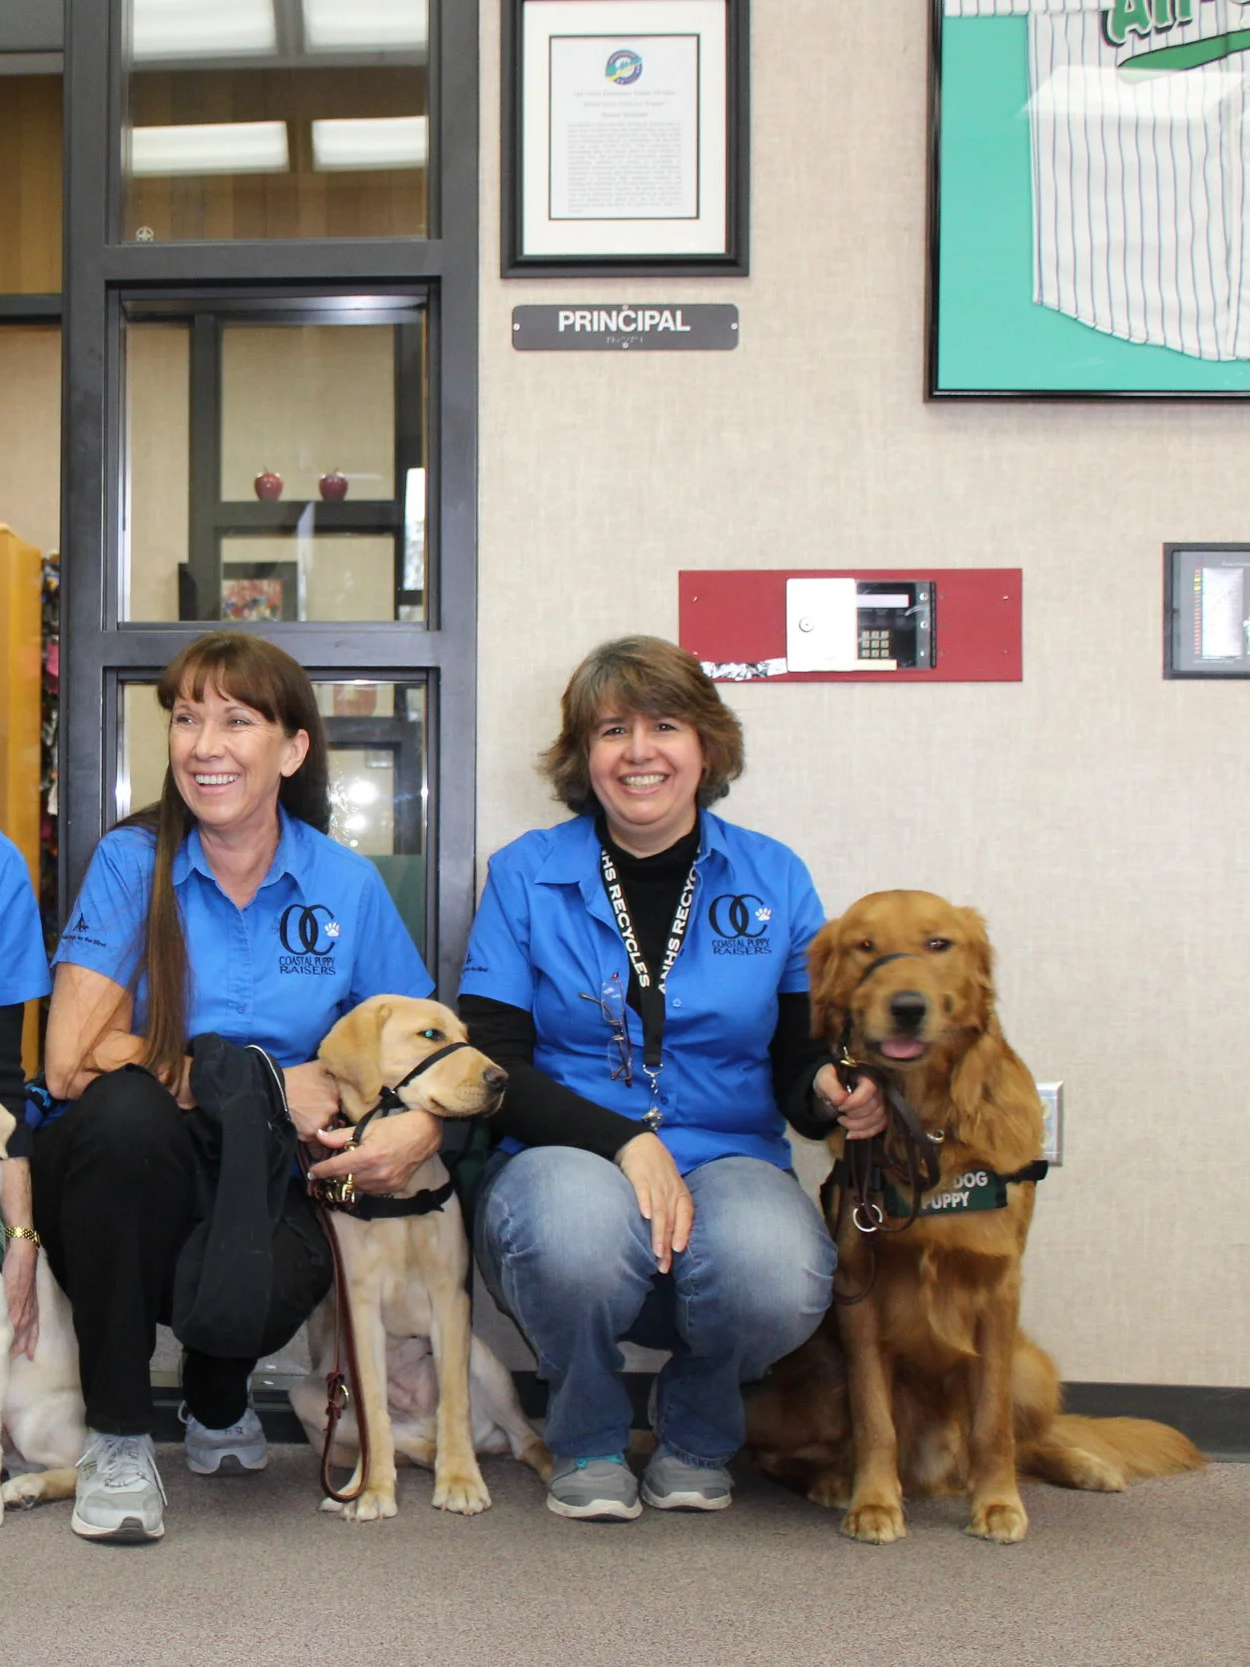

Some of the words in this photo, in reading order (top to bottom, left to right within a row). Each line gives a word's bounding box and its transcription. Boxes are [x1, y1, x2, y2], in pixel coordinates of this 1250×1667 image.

[558, 310, 691, 332] PRINCIPAL
[609, 884, 651, 988] RECYCLES
[712, 939, 746, 949] COASTAL
[748, 938, 770, 948] PUPPY
[713, 946, 772, 956] RAISERS
[279, 956, 313, 967] COASTAL
[315, 956, 336, 967] PUPPY
[279, 965, 337, 976] RAISERS
